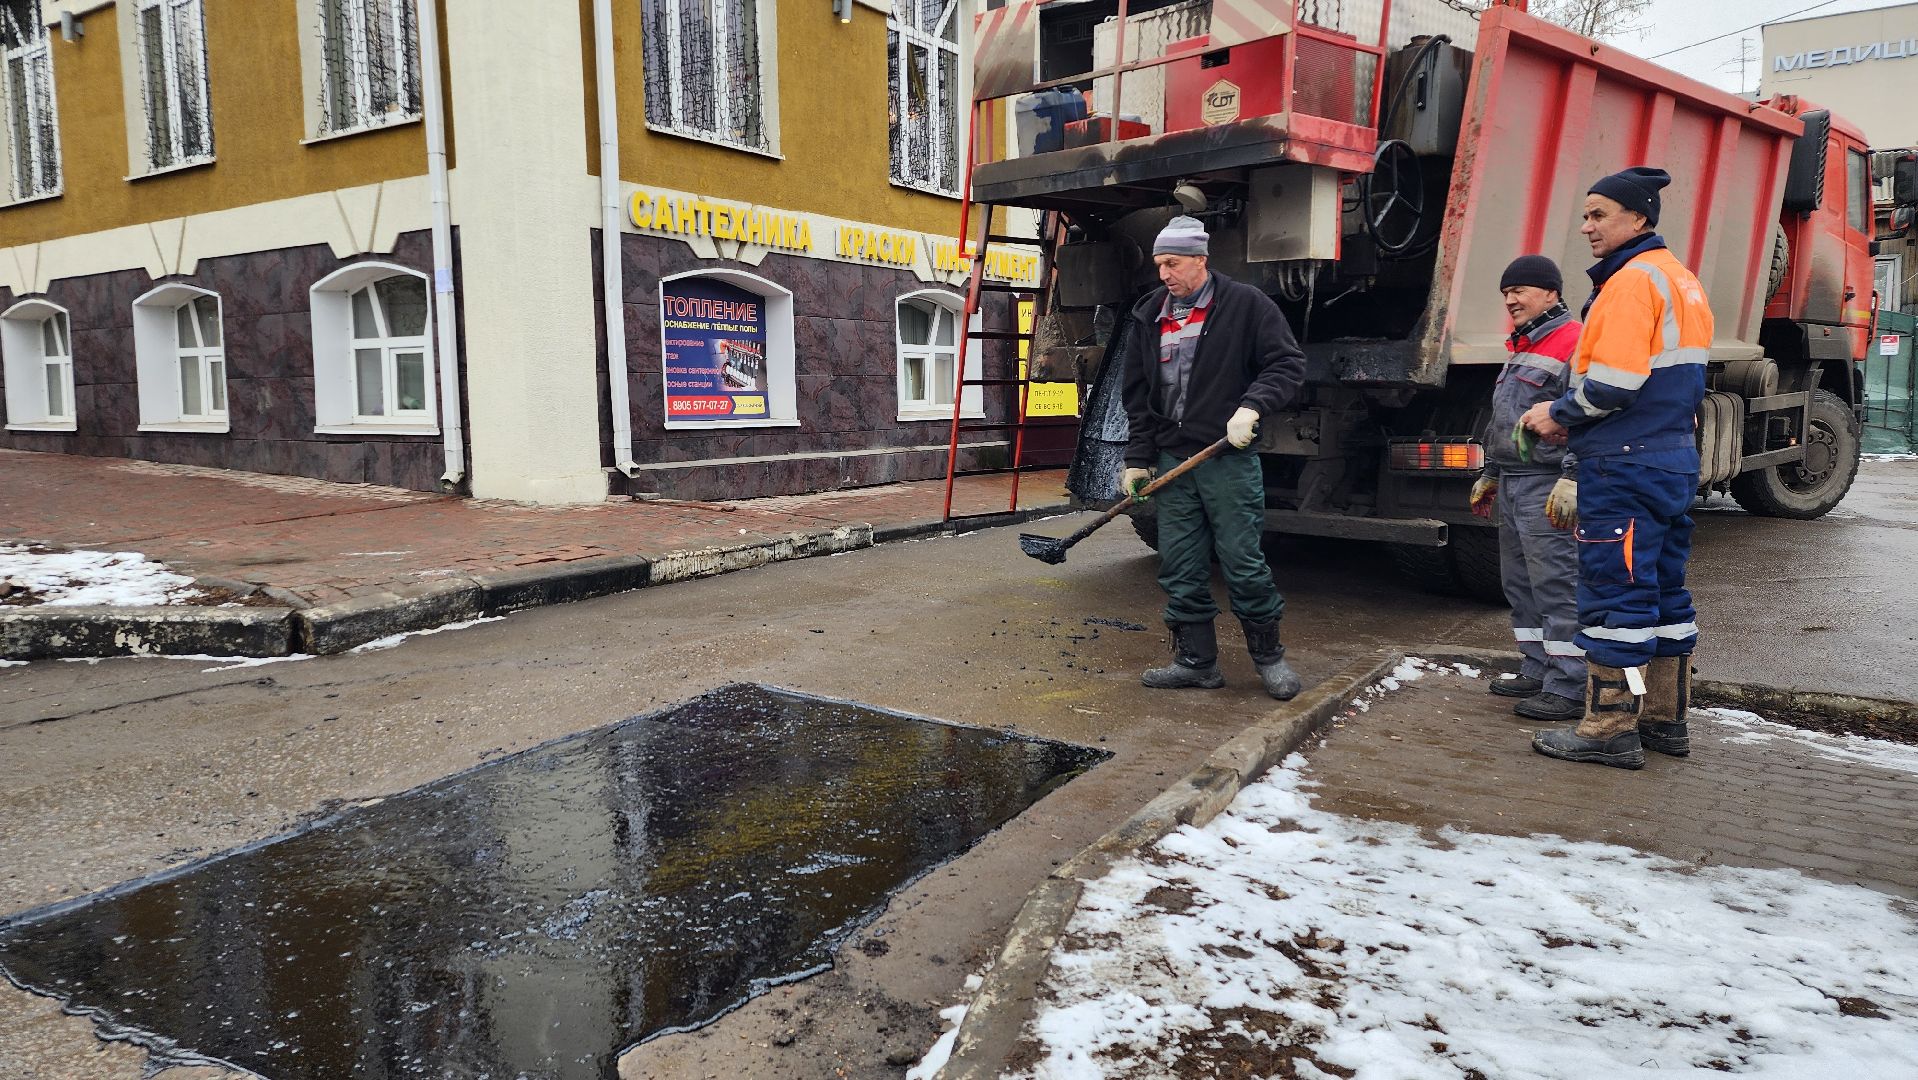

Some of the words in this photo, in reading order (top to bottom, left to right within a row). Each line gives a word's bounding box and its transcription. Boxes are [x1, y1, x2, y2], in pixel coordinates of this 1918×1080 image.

[628, 191, 814, 252] САНТЕХНИКА
[837, 225, 916, 266] КРАСКИ
[934, 242, 1038, 282] ИНСРУМЕНТ
[664, 295, 758, 322] ТОПЛЕНИЕ
[739, 325, 758, 334] ПОЛЫ
[672, 400, 692, 411] 8905
[693, 401, 729, 411] 577-07-27
